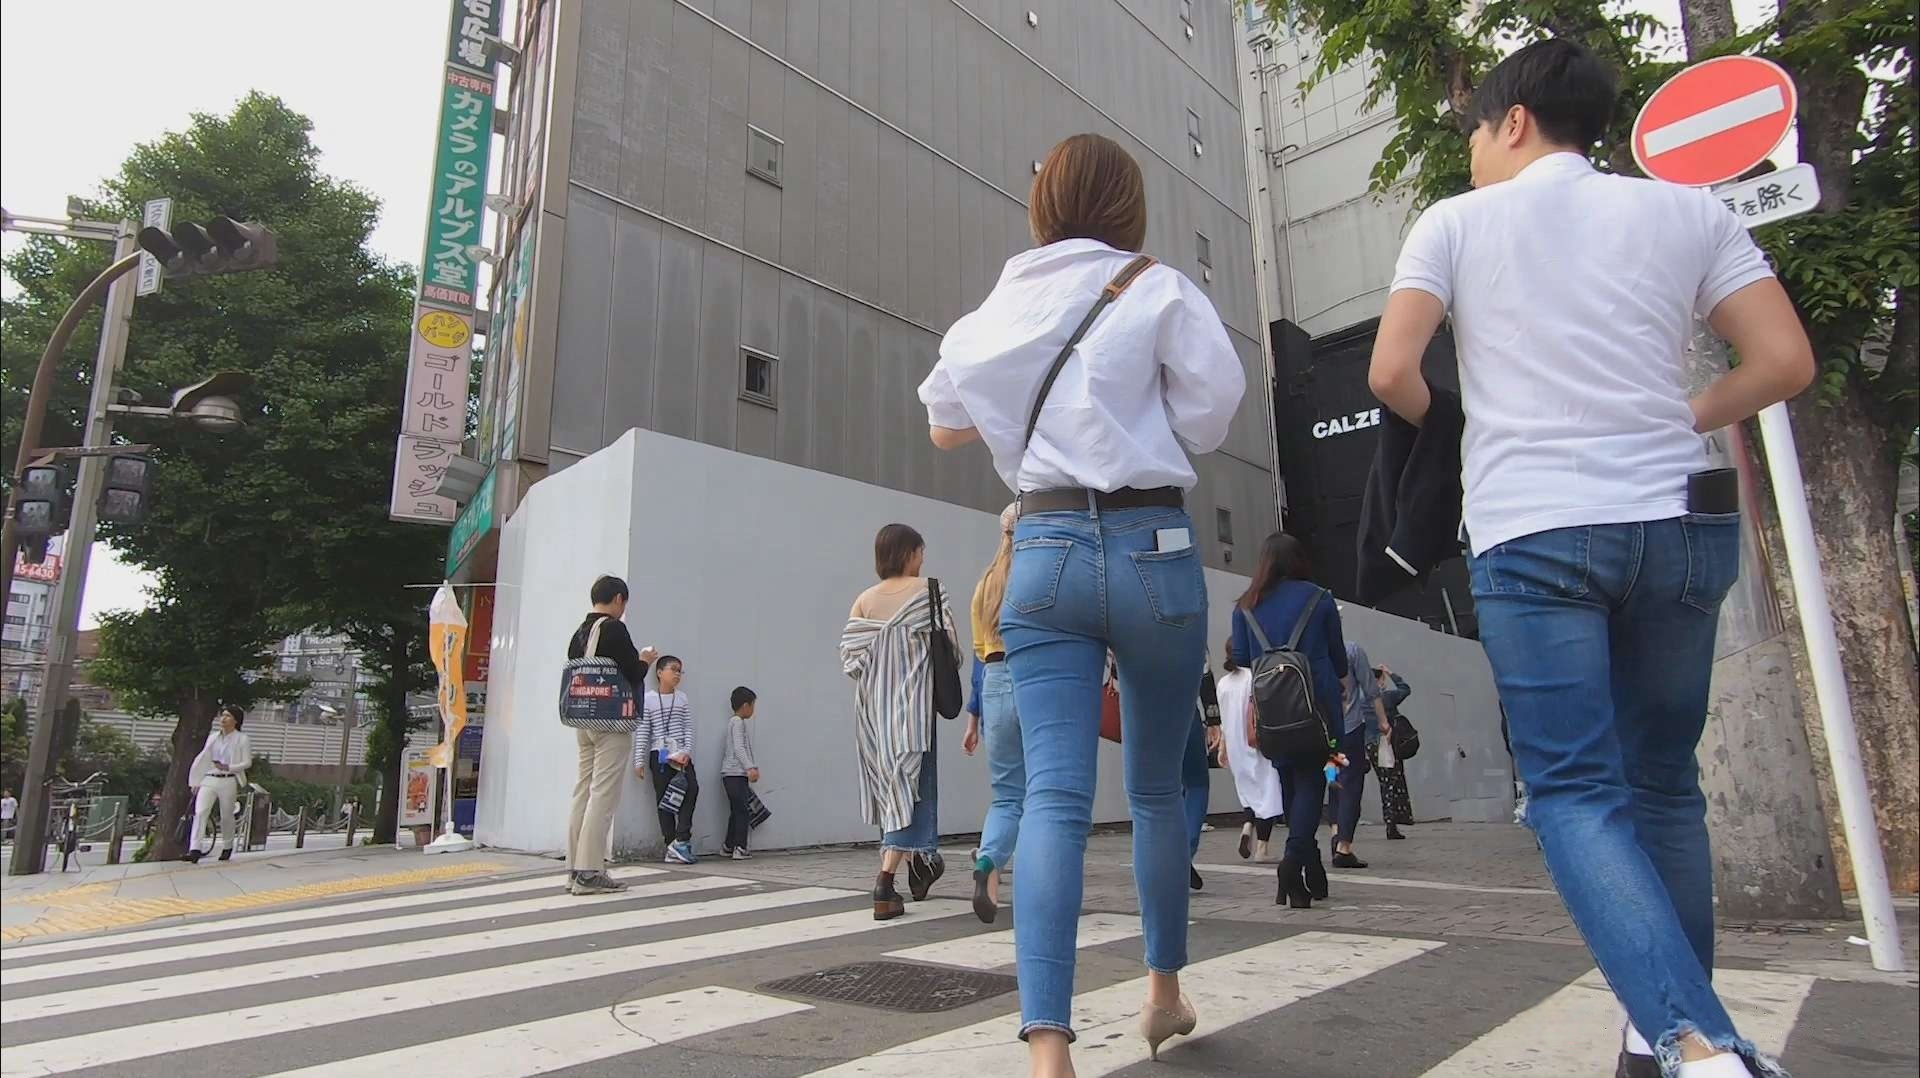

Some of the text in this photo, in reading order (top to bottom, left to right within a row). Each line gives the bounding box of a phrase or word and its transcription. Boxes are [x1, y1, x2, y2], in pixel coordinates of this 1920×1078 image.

[432, 91, 484, 289] カメラのアルプス堂
[408, 353, 460, 515] ゴールドラッシュ
[1312, 408, 1380, 439] CALZE
[570, 686, 609, 697] SINGAPORE
